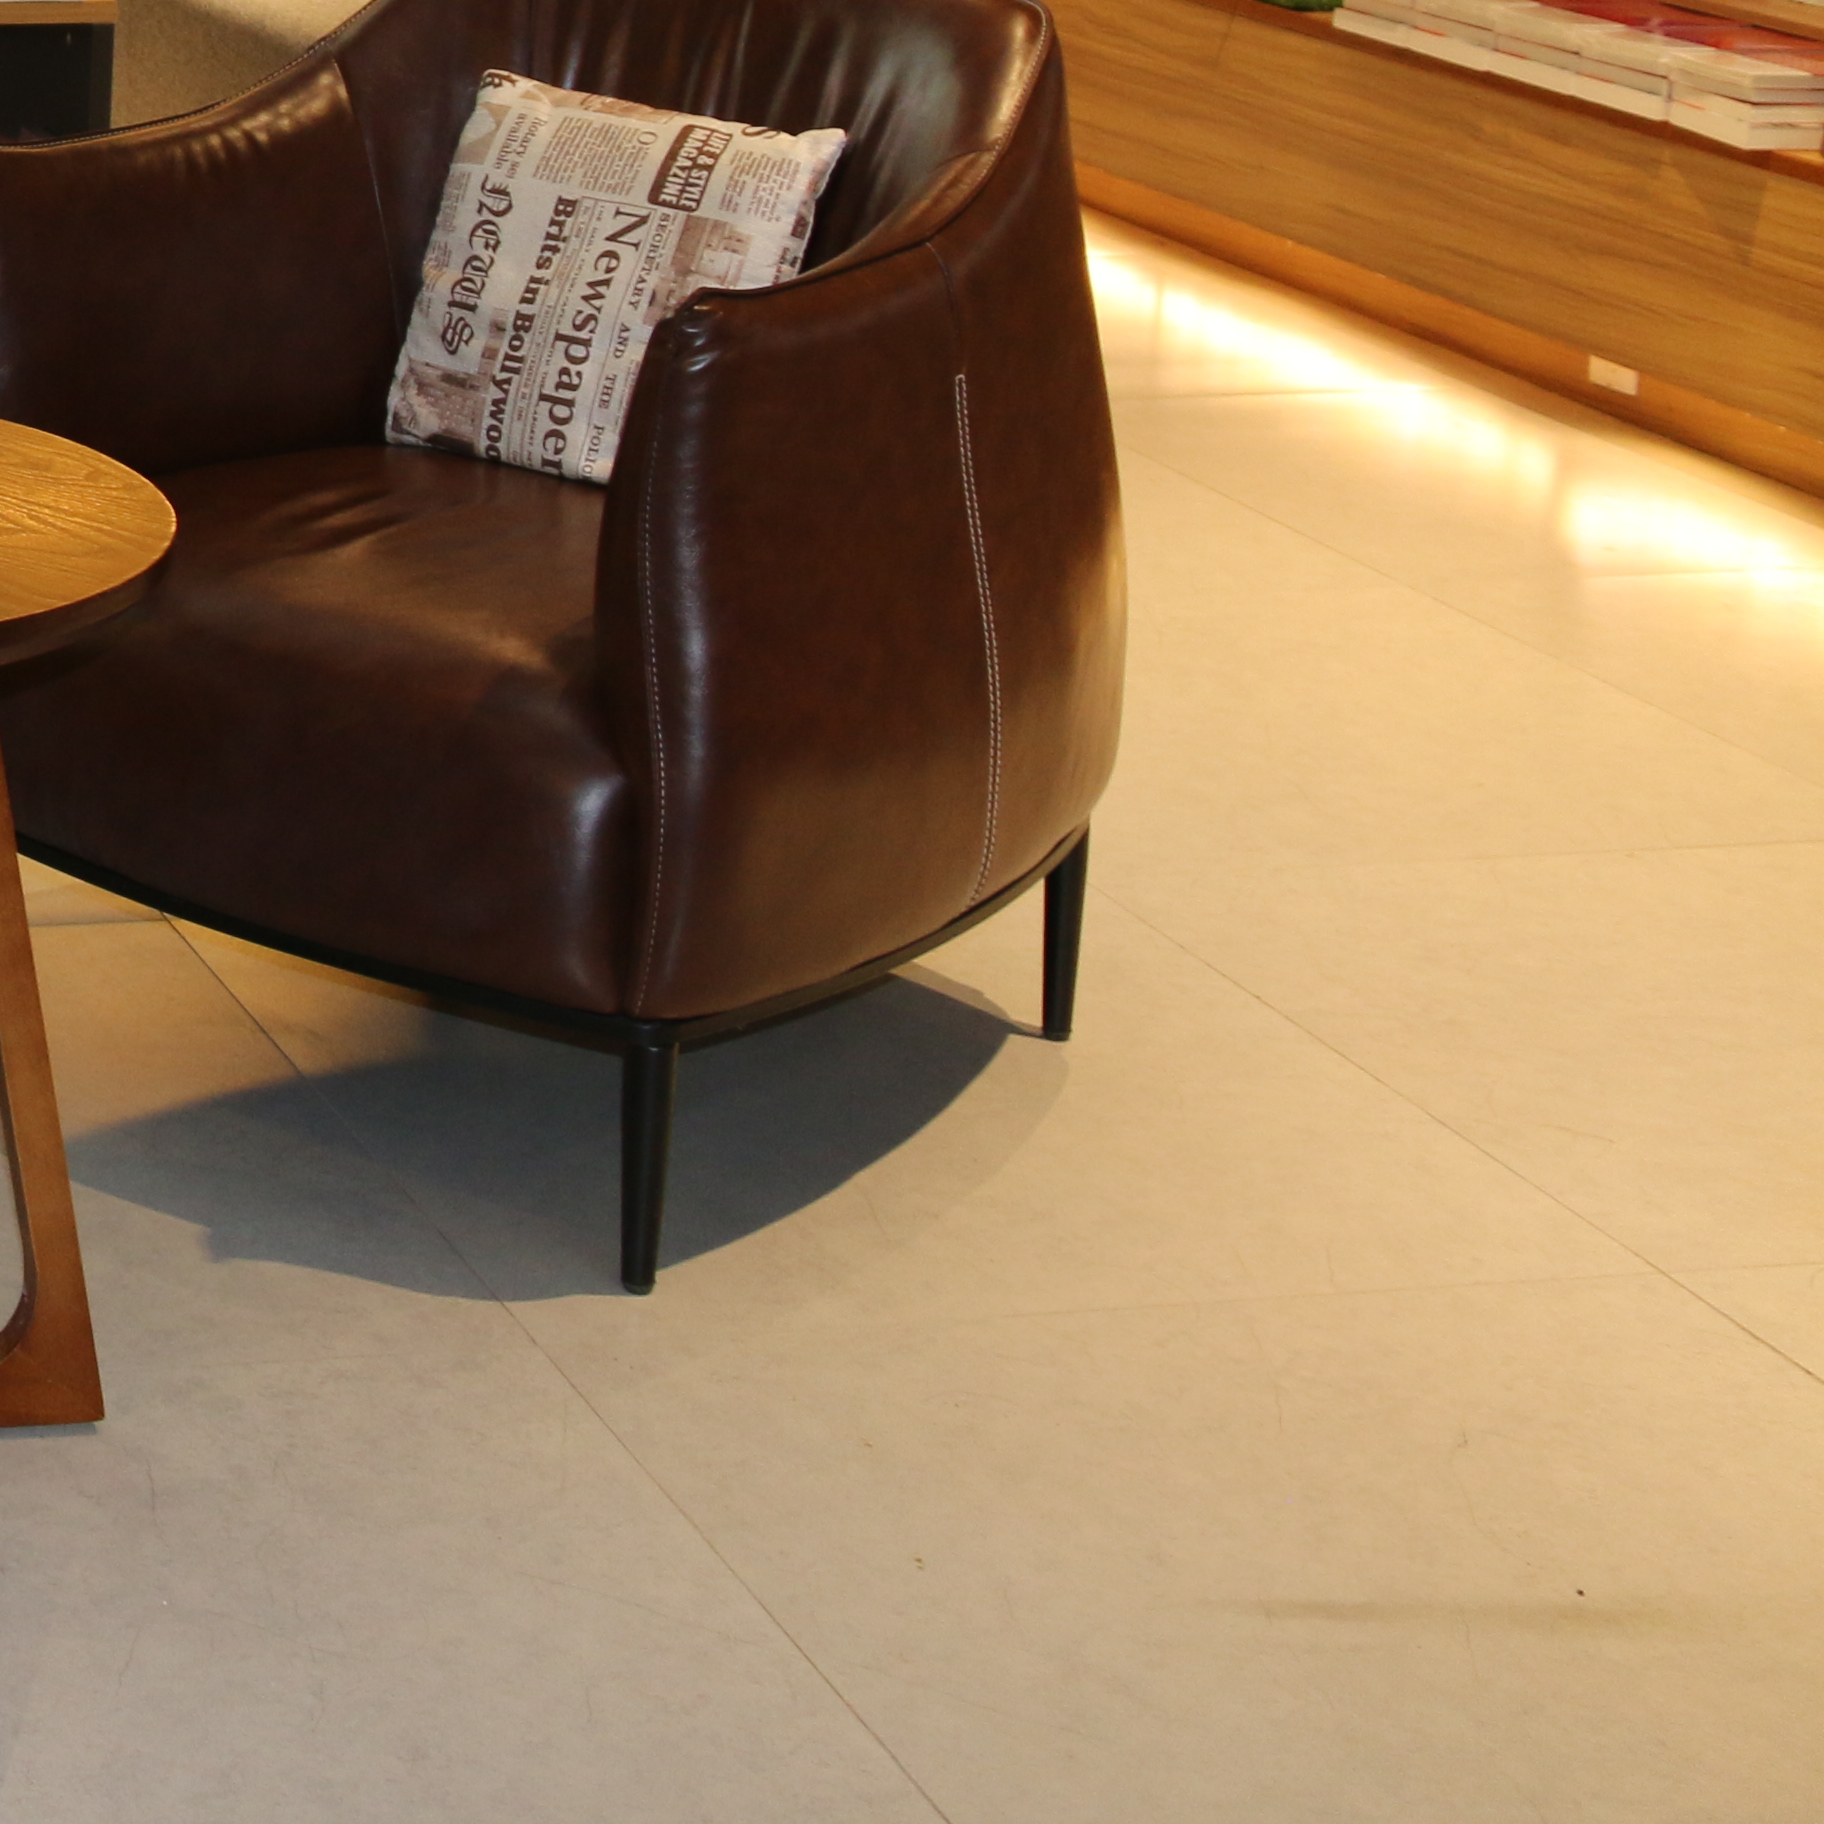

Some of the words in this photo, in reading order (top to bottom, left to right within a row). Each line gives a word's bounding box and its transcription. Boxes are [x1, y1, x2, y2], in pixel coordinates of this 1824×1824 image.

[493, 112, 528, 170] available
[514, 116, 548, 160] Rotary
[706, 131, 732, 156] LIFE
[658, 128, 706, 207] MAGAZINE
[698, 155, 714, 167] &
[678, 166, 712, 210] STYLE
[536, 194, 580, 271] Brits
[627, 211, 672, 311] SECRETARY
[519, 274, 551, 305] in
[538, 206, 652, 474] Newspaper
[613, 322, 632, 359] AND
[598, 372, 618, 410] THE
